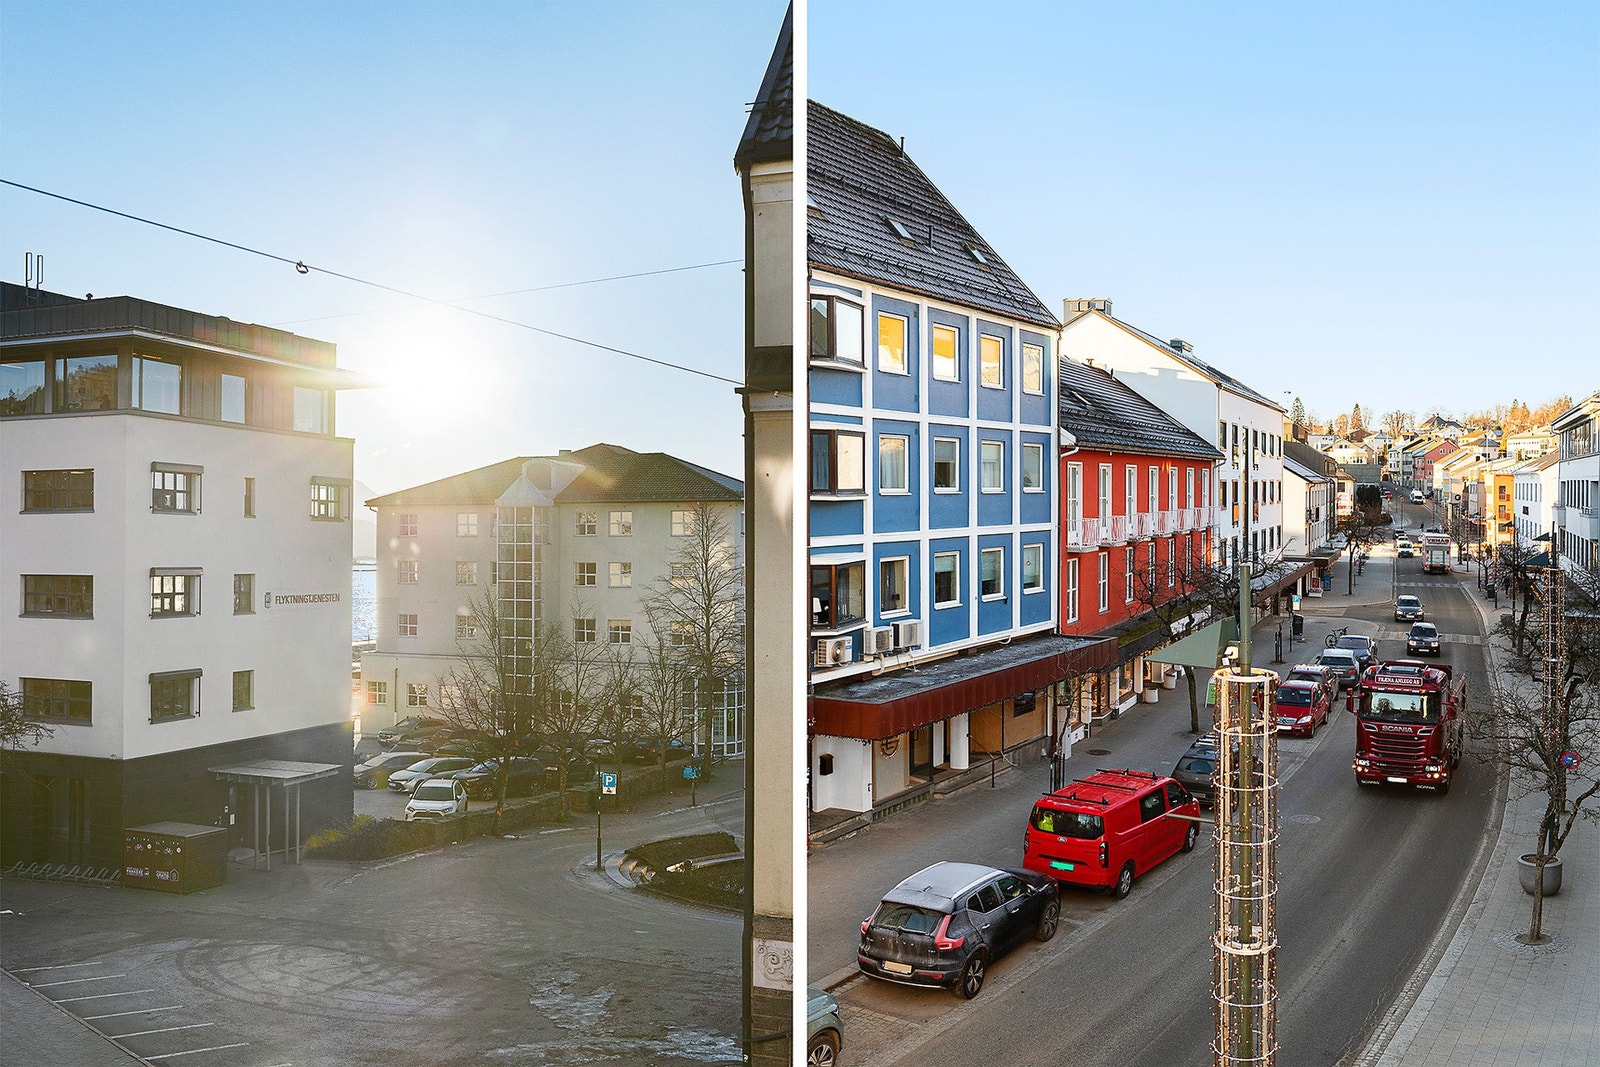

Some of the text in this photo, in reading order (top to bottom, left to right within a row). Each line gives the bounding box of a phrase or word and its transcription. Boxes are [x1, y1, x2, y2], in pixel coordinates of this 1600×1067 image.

[275, 593, 340, 604] FLYKTNINGTJENESTEN
[1382, 725, 1413, 733] SCANIA
[605, 775, 614, 786] P
